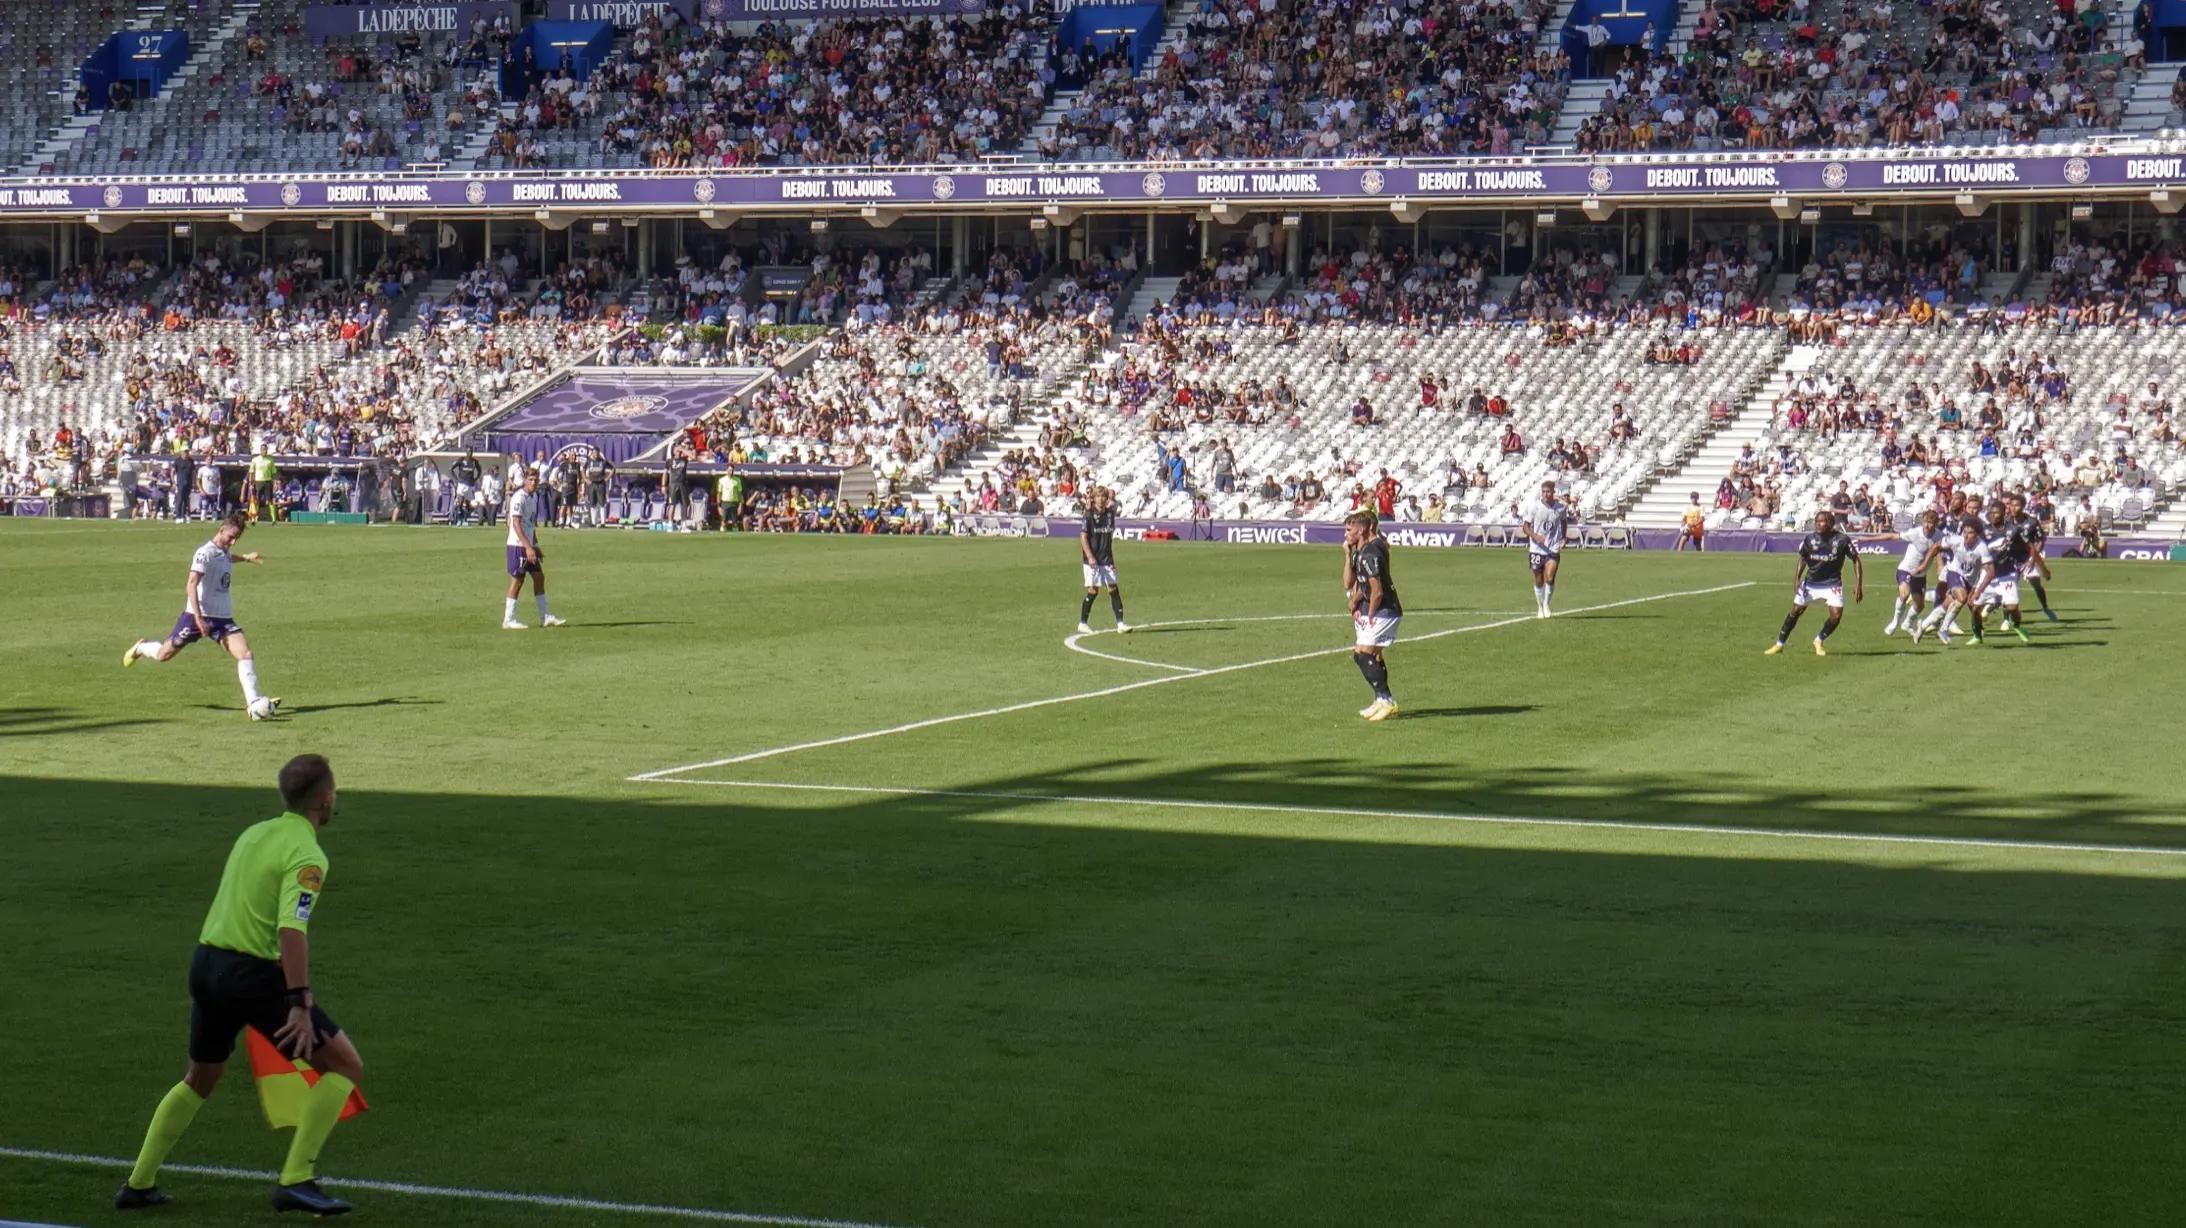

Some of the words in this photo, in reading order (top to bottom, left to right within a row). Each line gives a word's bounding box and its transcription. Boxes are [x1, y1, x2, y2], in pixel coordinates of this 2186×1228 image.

[744, 0, 818, 11] TOULOUSE
[358, 10, 380, 32] LA
[381, 5, 458, 31] DÉPÊCHE
[139, 36, 162, 53] 27
[1647, 168, 1702, 188] DEBOUT.
[1705, 167, 1779, 186] TOUJOURS.
[1884, 165, 1941, 183] DEBOUT.
[1944, 163, 2020, 182] TOUJOURS.
[2127, 159, 2185, 178] DEBOUT.
[783, 180, 829, 198] DEBOUT.
[832, 179, 897, 197] TOUJOURS.
[986, 177, 1036, 195] DEBOUT.
[1038, 177, 1104, 196] TOUJOURS.
[1198, 175, 1250, 194] DEBOUT.
[1251, 173, 1321, 193] TOUJOURS.
[1419, 171, 1471, 191] DEBOUT.
[1475, 170, 1547, 190] TOUJOURS.
[0, 190, 16, 205] UT.
[17, 189, 73, 205] TOUJOURS.
[147, 188, 190, 204] DEBOUT.
[192, 187, 250, 203] TOUJOURS.
[327, 186, 371, 202] DEBOUT.
[373, 185, 431, 201] TOUJOURS.
[513, 184, 559, 200] DEBOUT.
[561, 183, 622, 200] TOUJOURS.
[1112, 527, 1148, 540] AFT
[1227, 523, 1308, 544] newrest
[1381, 528, 1456, 547] etway
[1531, 554, 1541, 564] 28
[2120, 549, 2171, 560] CRA
